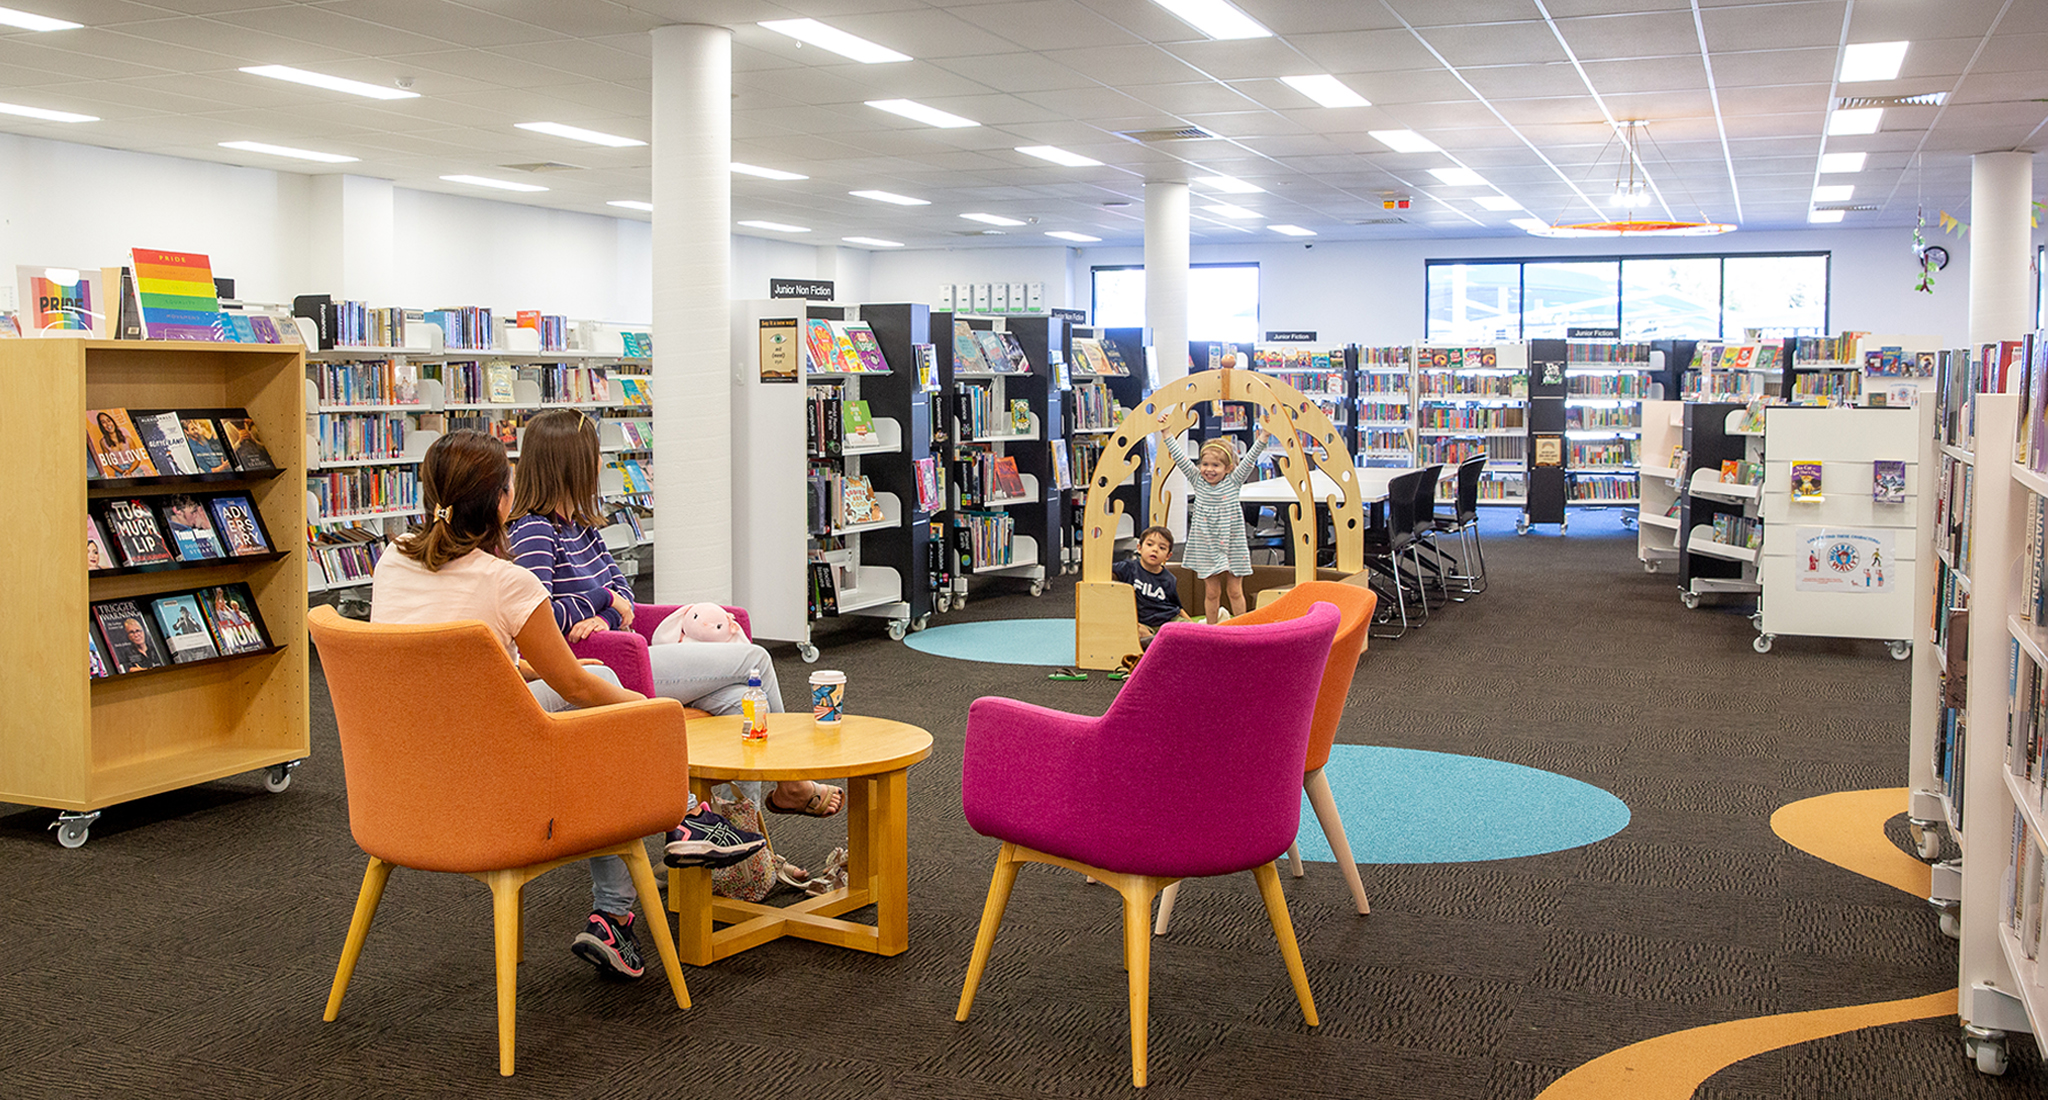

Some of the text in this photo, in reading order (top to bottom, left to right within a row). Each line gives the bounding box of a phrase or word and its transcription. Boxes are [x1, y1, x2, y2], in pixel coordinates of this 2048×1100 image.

[158, 254, 186, 263] PRIDE
[774, 284, 831, 295] Junior Non Fiction
[40, 296, 84, 314] PRIDE
[98, 447, 150, 467] BIG LOVE
[222, 505, 248, 519] ADV
[117, 518, 158, 537] MUCH
[227, 518, 255, 533] ERS
[132, 536, 156, 553] LIP
[233, 532, 260, 546] ARY
[2032, 512, 2044, 600] NAPOLEON
[1832, 560, 1857, 571] WALLY
[822, 567, 832, 588] Social
[1133, 579, 1166, 600] FILA
[97, 601, 138, 614] TRIGGER
[99, 611, 142, 620] WARNING
[220, 622, 261, 650] MUM
[2009, 641, 2017, 680] SHINING
